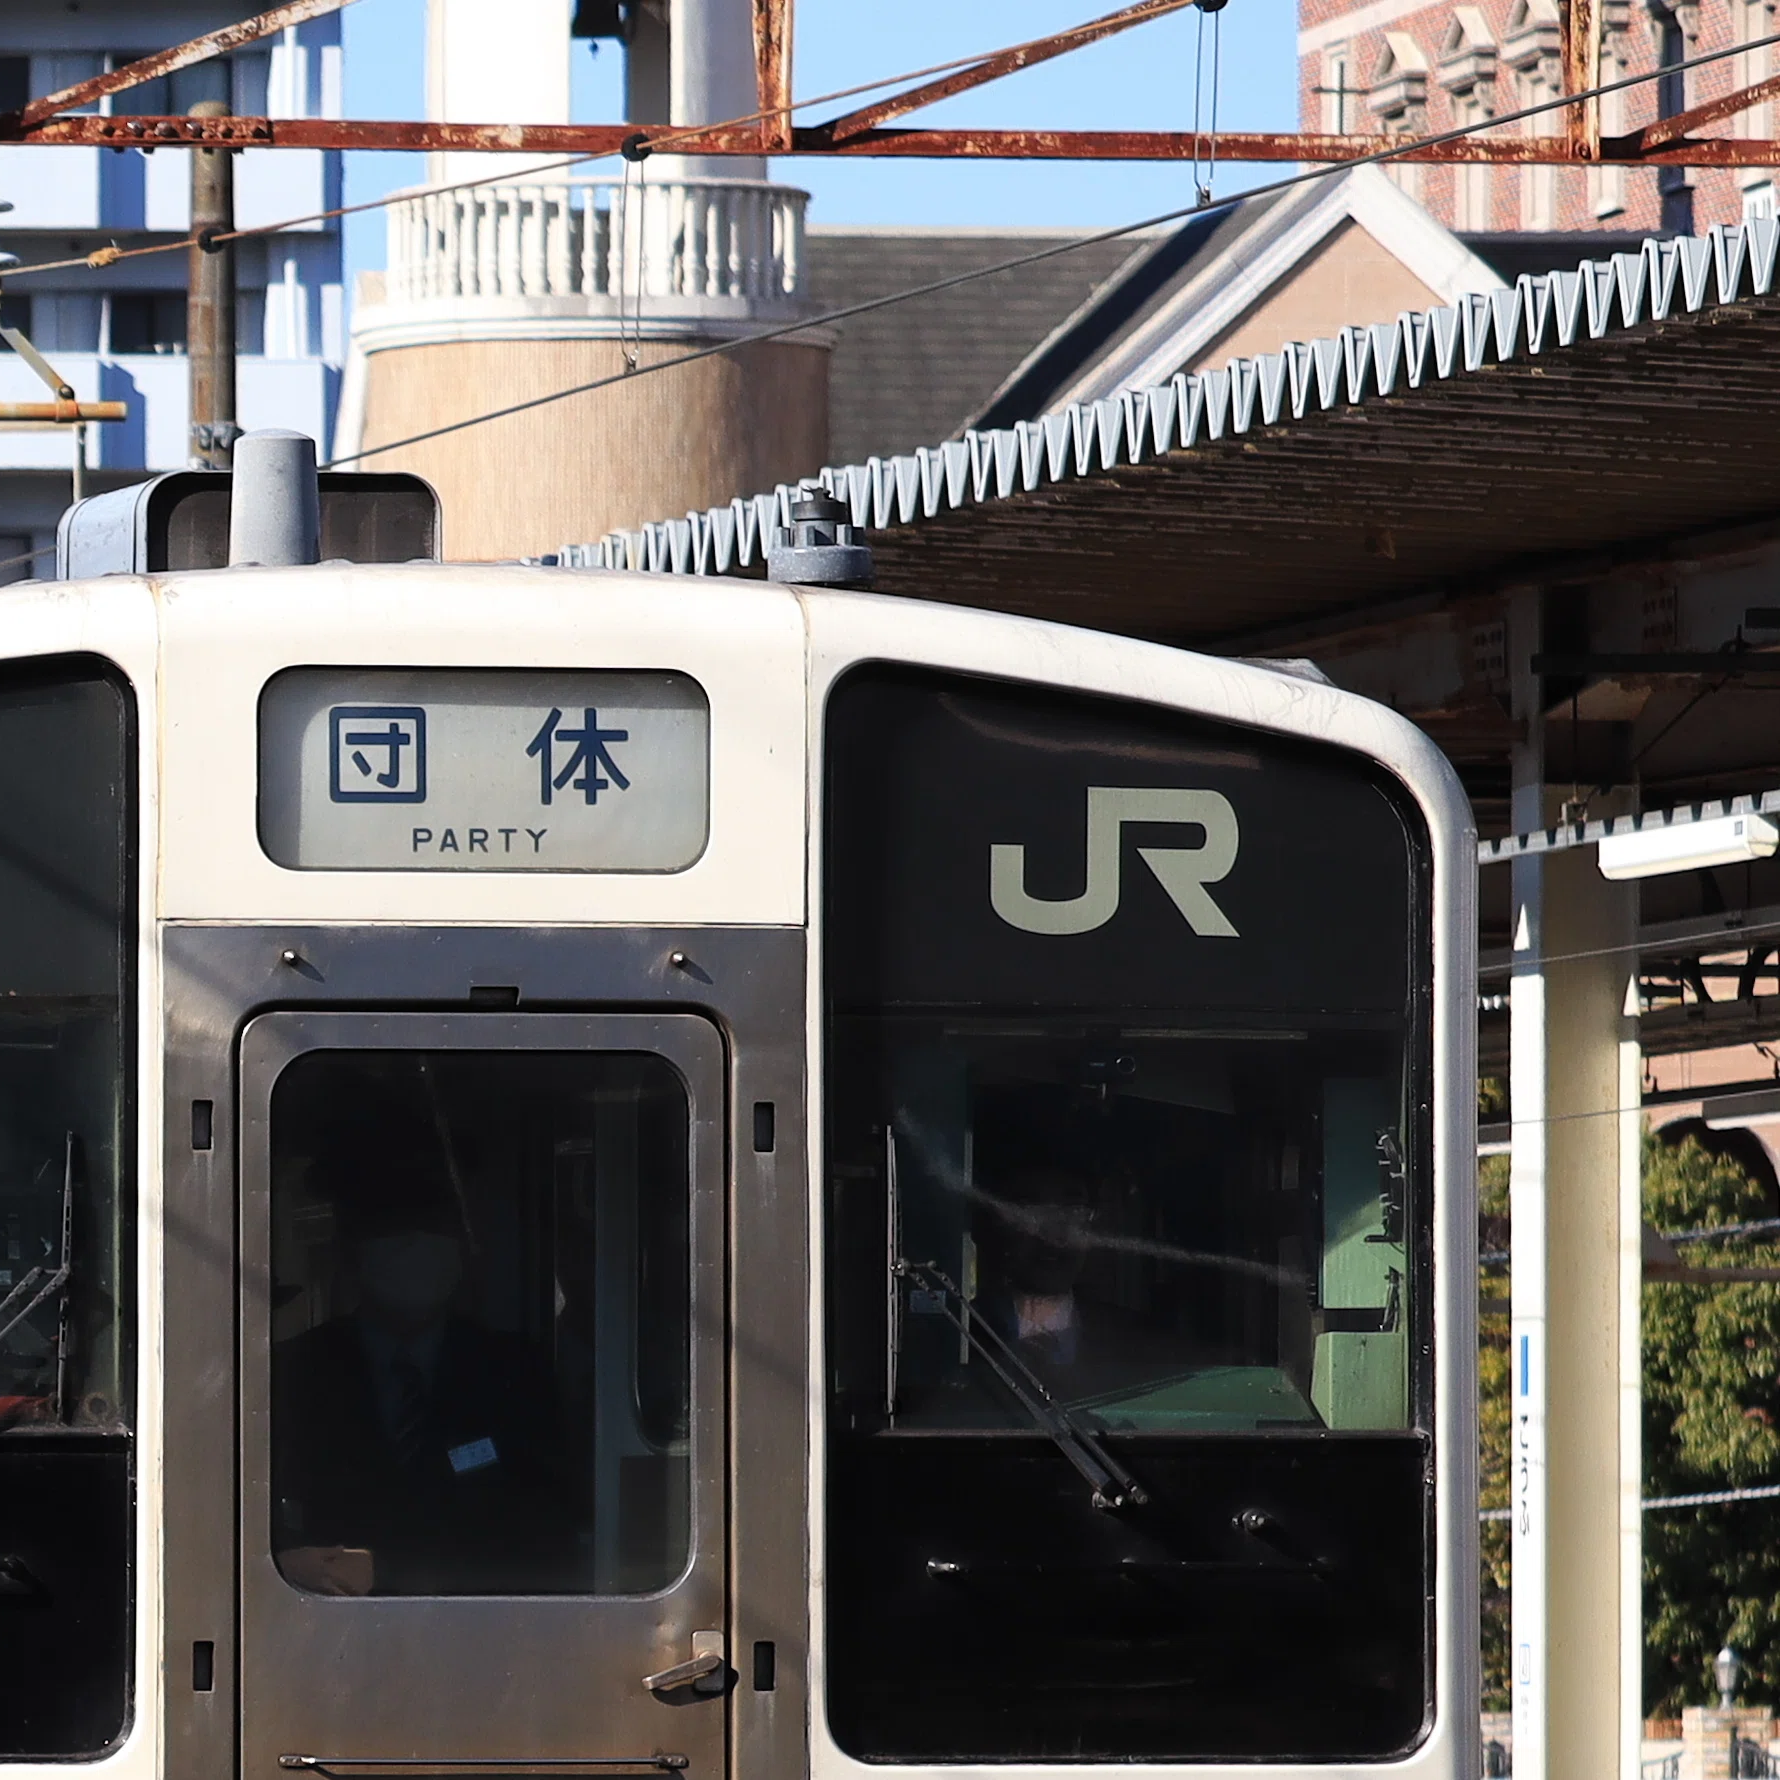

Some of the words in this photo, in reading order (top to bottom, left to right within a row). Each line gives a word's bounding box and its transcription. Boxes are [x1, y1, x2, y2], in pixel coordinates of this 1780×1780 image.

[328, 706, 631, 806] 団体
[412, 828, 549, 853] PARTY
[989, 785, 1241, 938] JR
